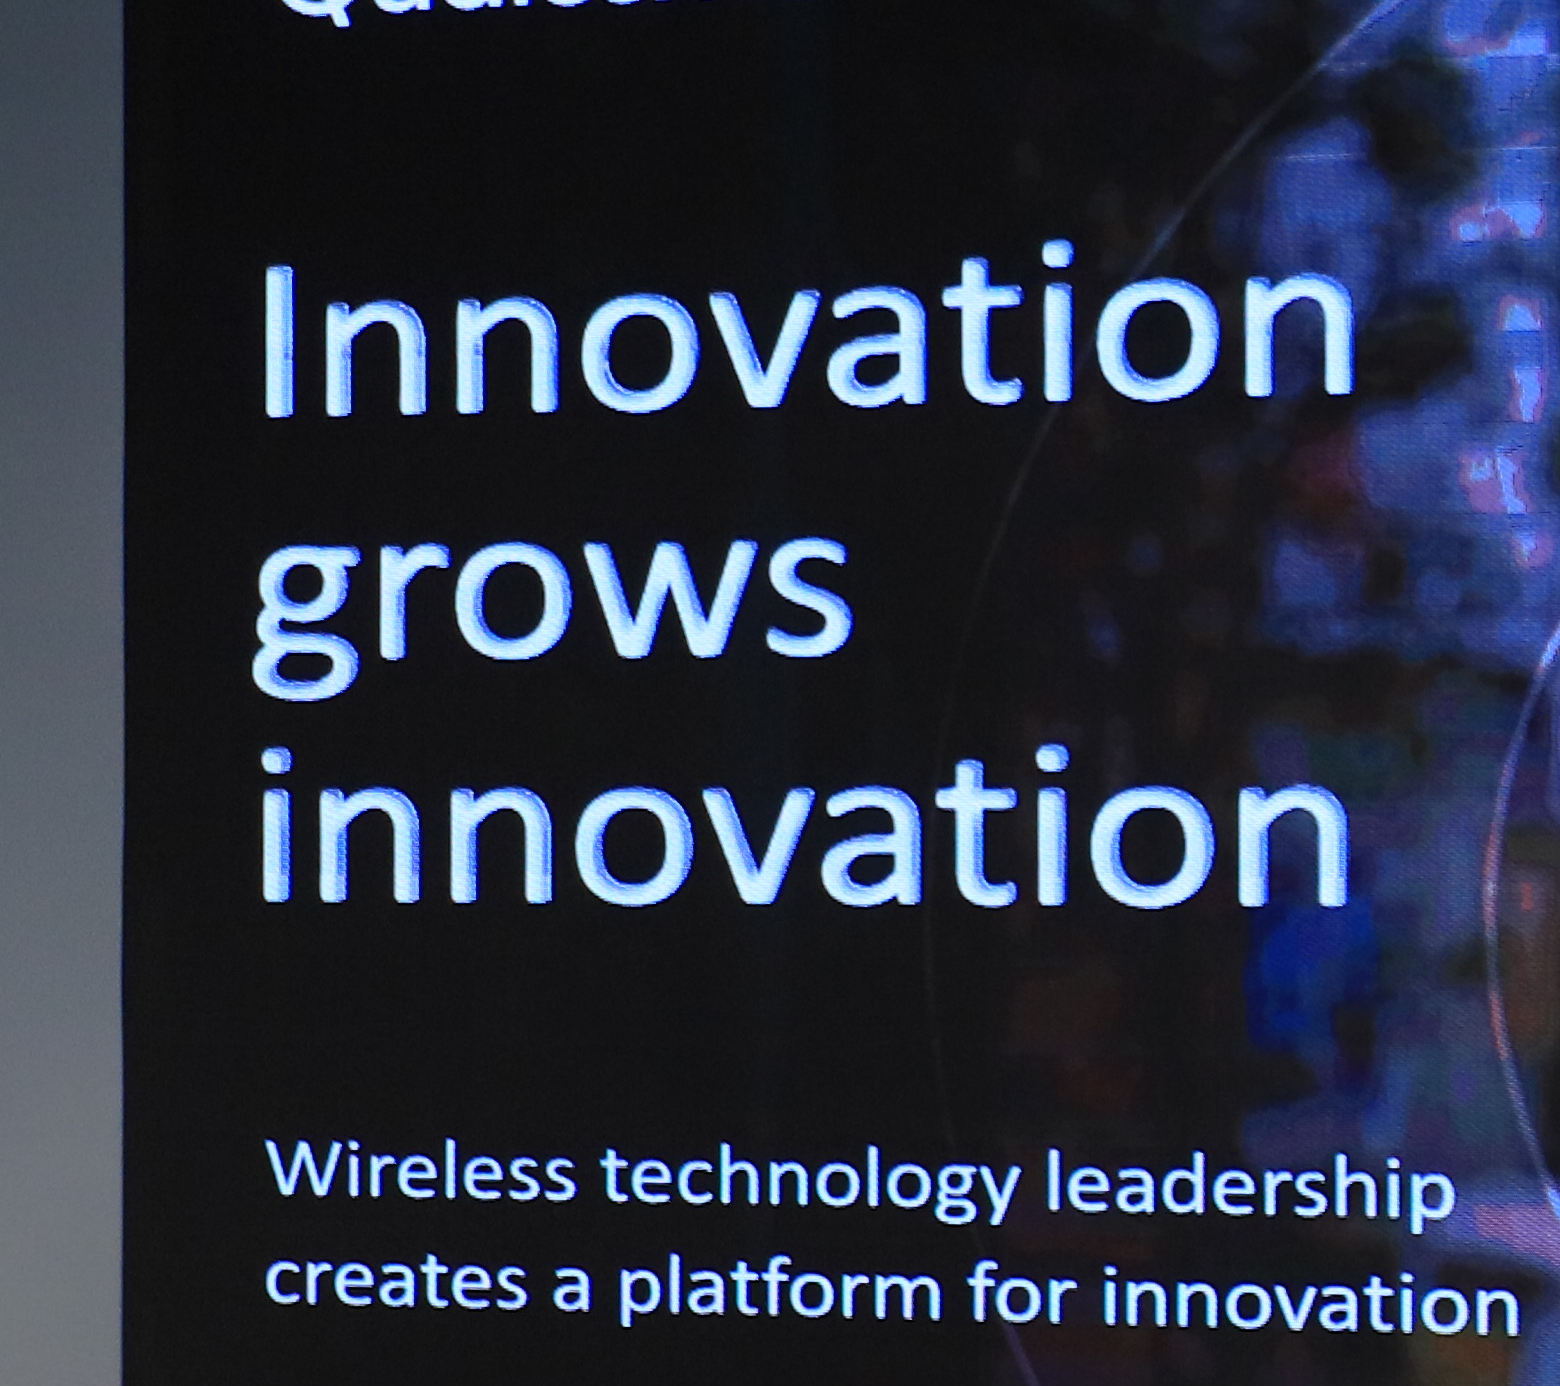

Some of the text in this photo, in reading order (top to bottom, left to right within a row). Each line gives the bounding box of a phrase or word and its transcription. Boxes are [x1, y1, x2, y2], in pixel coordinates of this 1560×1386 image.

[264, 240, 1354, 419] Innovation
[251, 537, 852, 703] grows
[260, 743, 1348, 910] innovation
[265, 1138, 1457, 1235] Wireless technology leadership
[266, 1253, 1520, 1337] creates a platform for innovation
